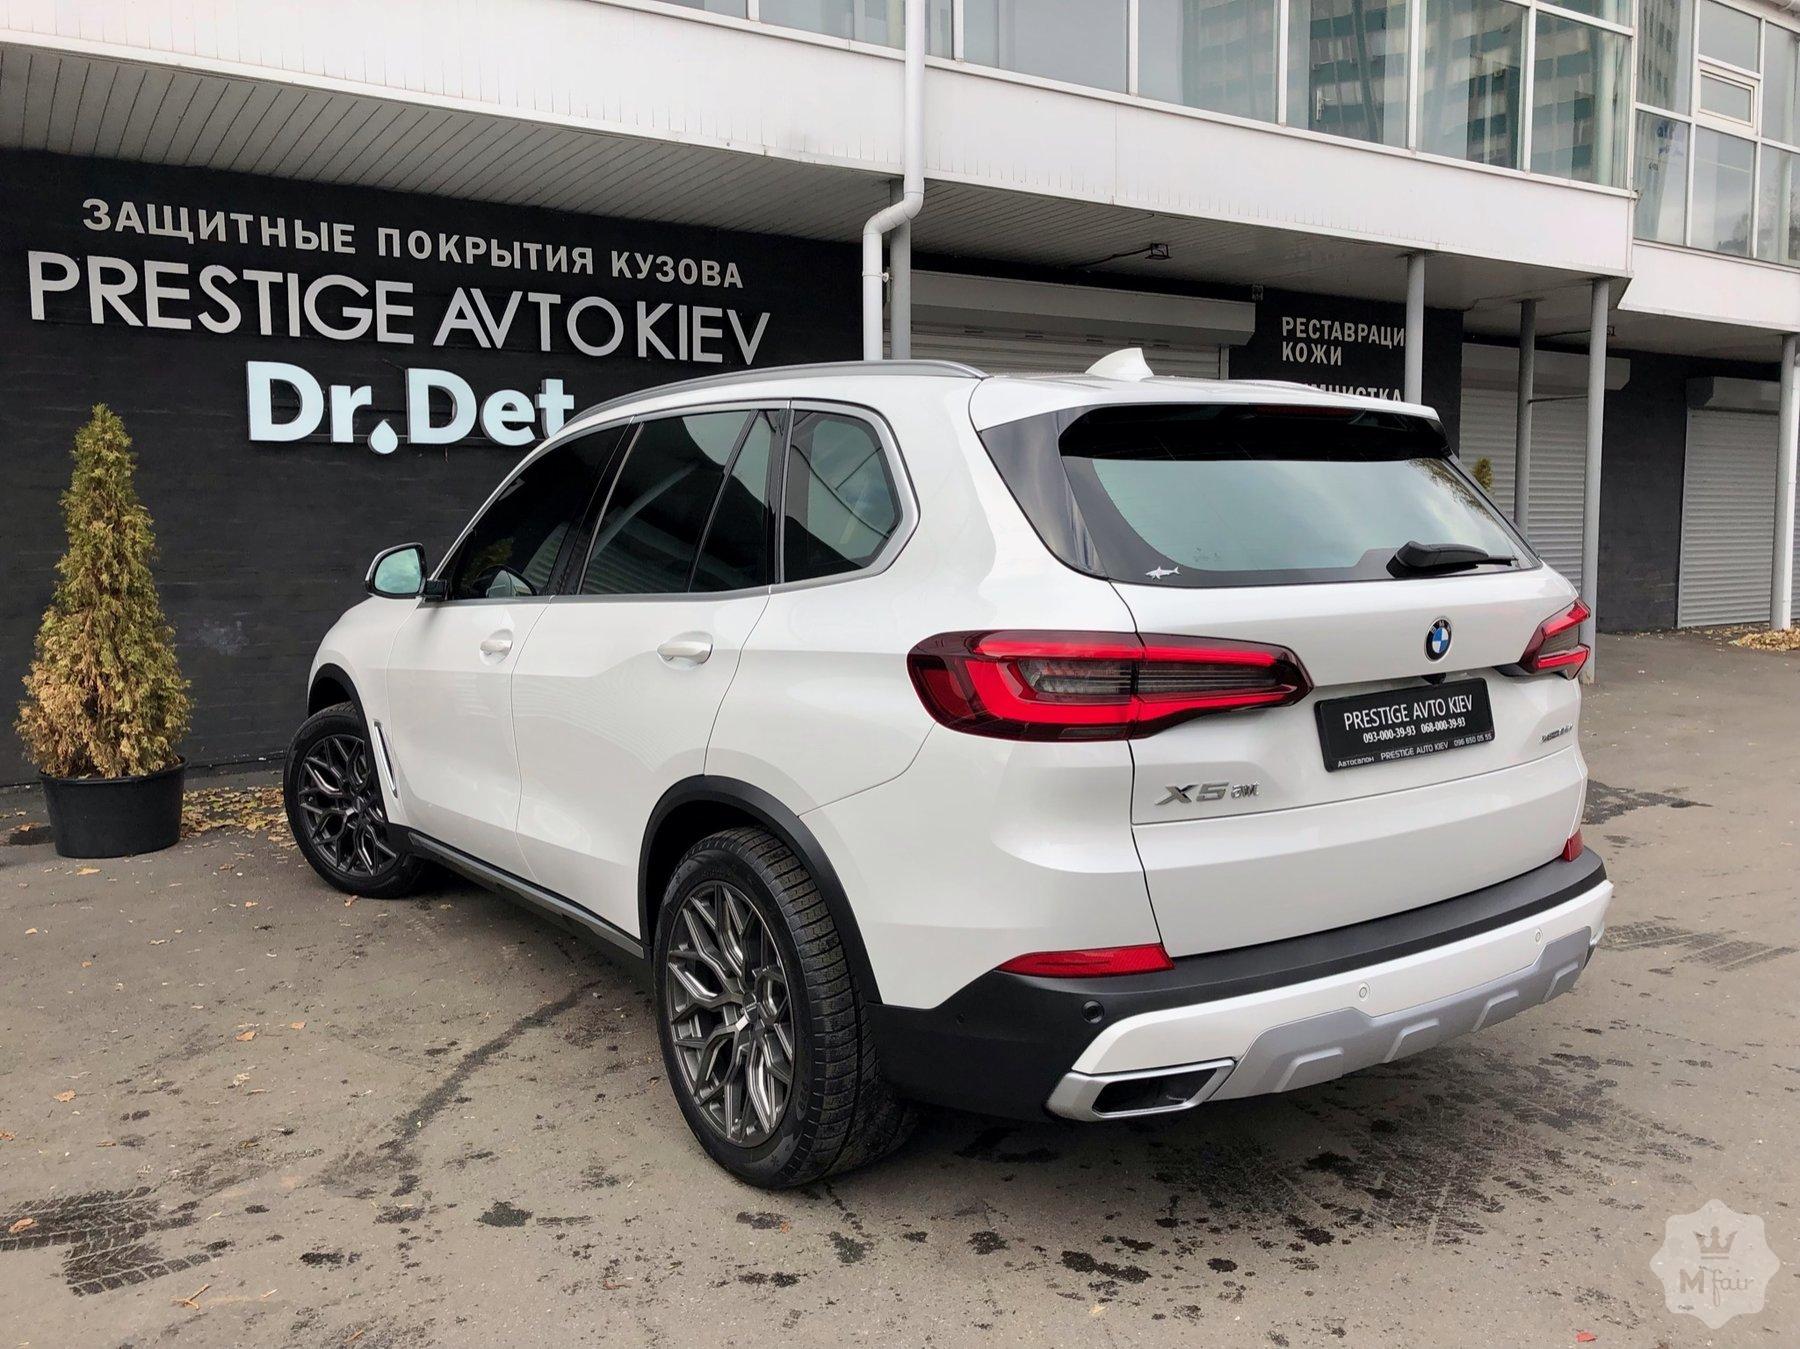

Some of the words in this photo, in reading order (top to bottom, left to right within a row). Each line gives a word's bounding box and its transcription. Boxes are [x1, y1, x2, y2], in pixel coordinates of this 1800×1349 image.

[82, 198, 356, 254] ЗАЩИТНЫЕ
[377, 227, 594, 275] ПОКРЫТИЯ
[611, 250, 743, 289] КУЗОВА
[28, 250, 414, 345] PRESTIGE
[1281, 316, 1405, 348] РЕСТАВРАЦИ
[1281, 341, 1342, 366] КОЖИ
[1343, 703, 1410, 731] PRESTIGE
[1413, 698, 1446, 721] AVTO
[1449, 694, 1474, 714] KIEV
[1363, 725, 1416, 744] 093-000-39-93
[1420, 717, 1466, 734] 068-000-39-93
[1380, 746, 1415, 761] PRESTIGE
[1416, 743, 1434, 755] AUTO
[1434, 741, 1449, 752] KIEV
[1154, 781, 1229, 806] X5
